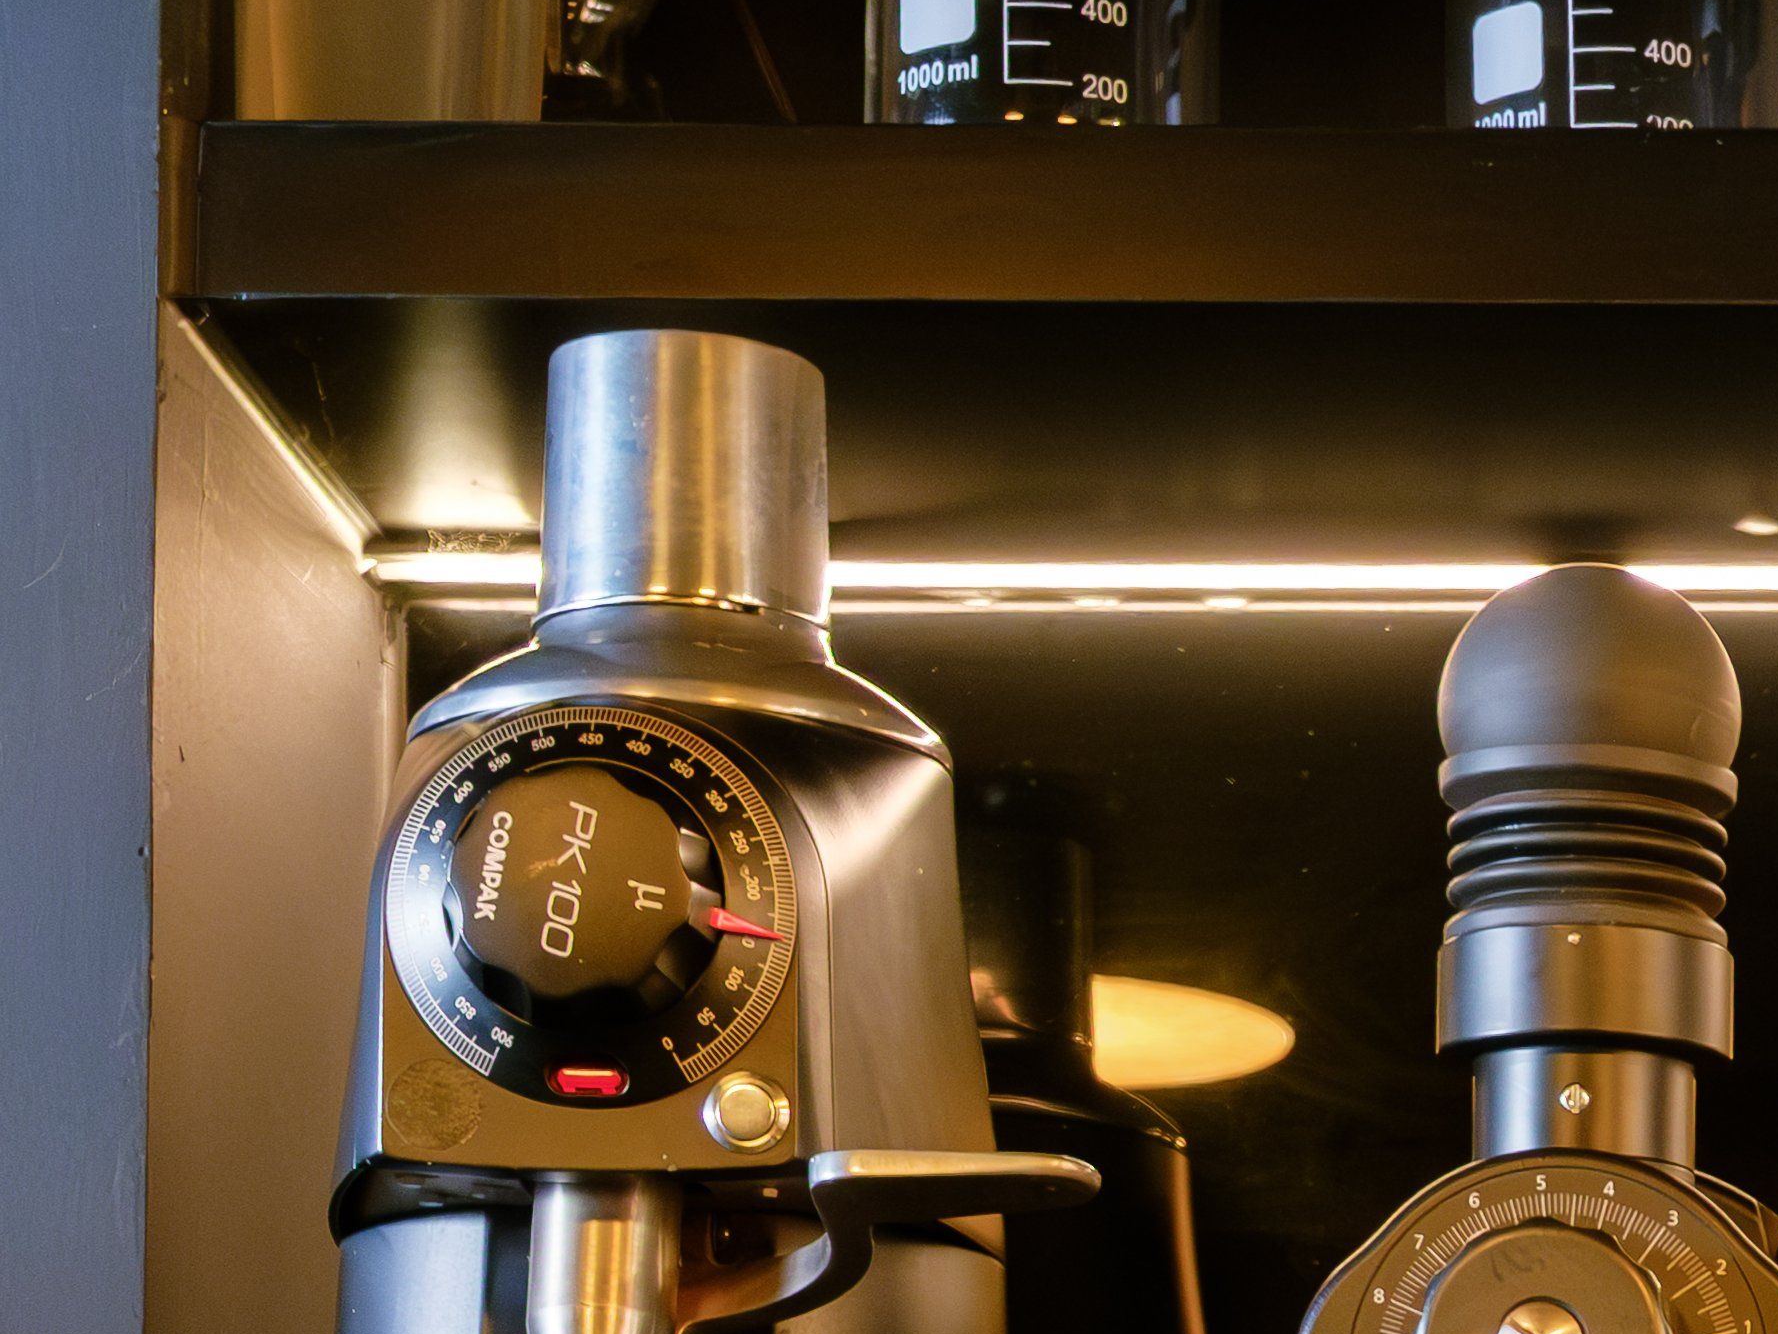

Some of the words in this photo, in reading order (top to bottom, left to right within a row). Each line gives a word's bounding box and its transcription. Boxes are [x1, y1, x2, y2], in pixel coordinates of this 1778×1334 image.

[1643, 39, 1691, 67] 400
[898, 61, 944, 95] 1000
[947, 54, 979, 85] ml
[1082, 73, 1128, 104] 200
[531, 735, 556, 751] 500
[578, 732, 604, 746] 450
[624, 738, 652, 756] 400
[488, 751, 512, 773] 550
[669, 757, 695, 779] 350
[453, 780, 474, 804] 600
[704, 789, 729, 814] 300
[429, 819, 447, 844] 650
[729, 830, 750, 856] 250
[473, 810, 512, 921] COMPAK
[725, 965, 745, 991] 100
[454, 995, 477, 1020] 850
[696, 1006, 716, 1026] 50
[490, 1026, 515, 1048] 900
[1535, 1175, 1546, 1191] 5
[1603, 1182, 1615, 1197] 4
[1468, 1193, 1480, 1209] 6
[1667, 1210, 1679, 1226] 3
[1414, 1234, 1425, 1250] 7
[1716, 1260, 1728, 1276] 2
[1374, 1288, 1385, 1304] 8
[1744, 1320, 1752, 1334] 1
